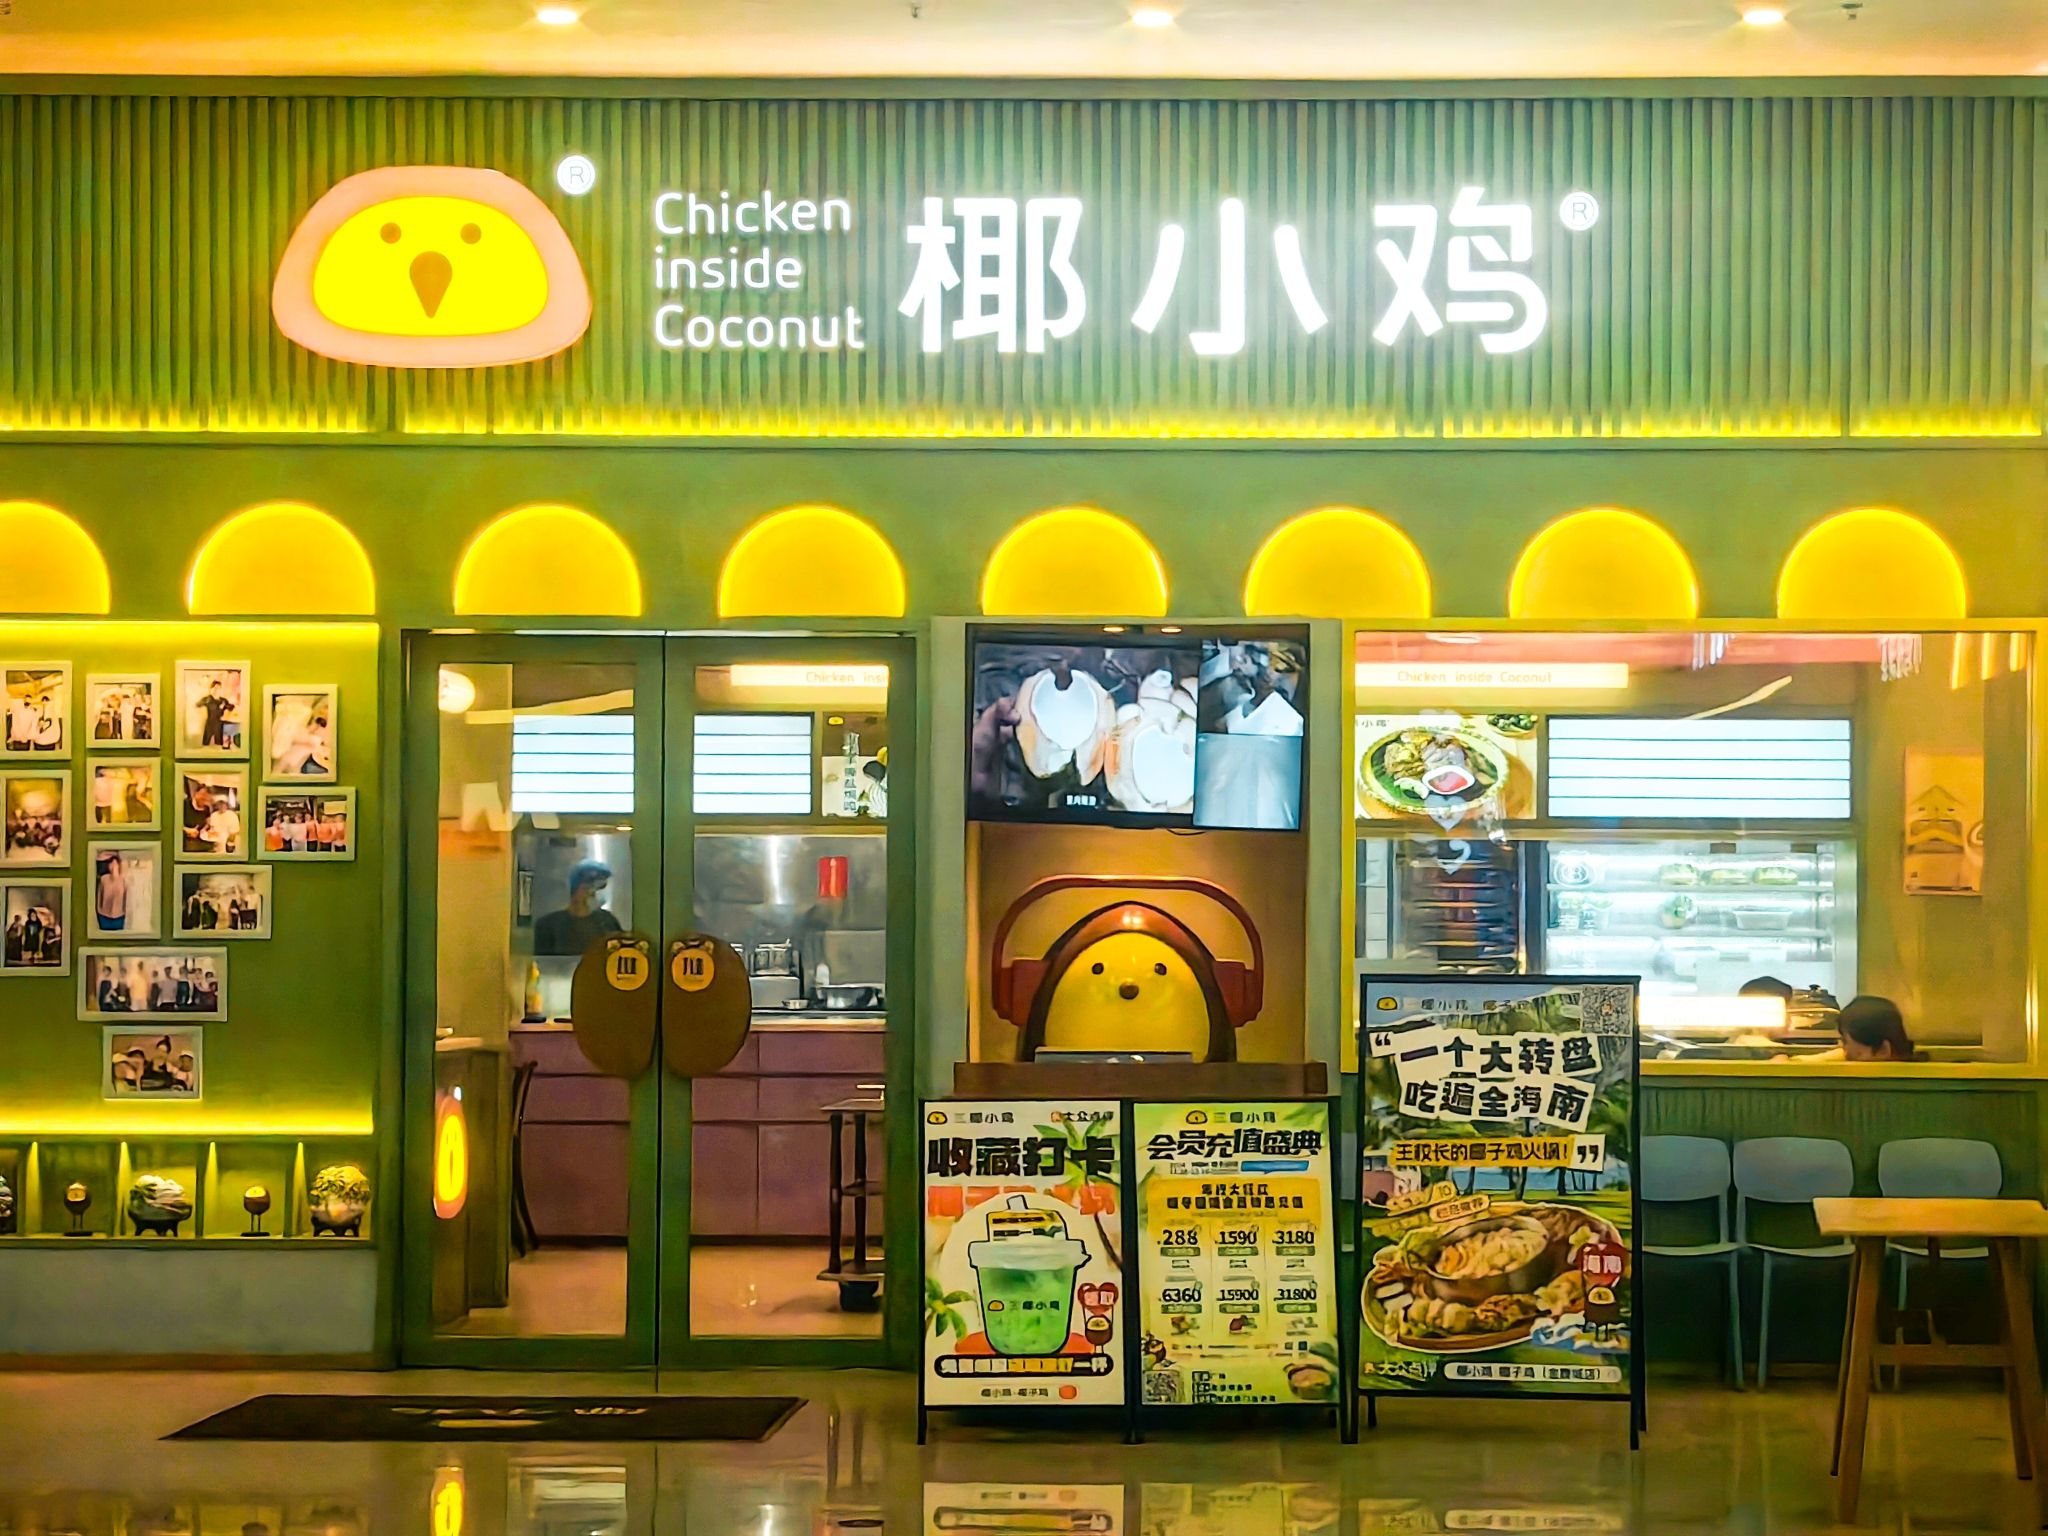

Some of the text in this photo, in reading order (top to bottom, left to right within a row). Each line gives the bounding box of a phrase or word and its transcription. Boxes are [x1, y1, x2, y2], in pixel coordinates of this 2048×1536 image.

[655, 190, 850, 234] Chicken
[655, 245, 802, 289] inside
[898, 186, 1547, 355] 椰小鸡
[655, 304, 864, 349] Coconut
[1398, 671, 1552, 683] Chicken inside Coconut
[1404, 1080, 1589, 1122] 吃遍全海南
[928, 1137, 1115, 1177] 收藏打卡
[1147, 1128, 1322, 1160] 会员充值盛典
